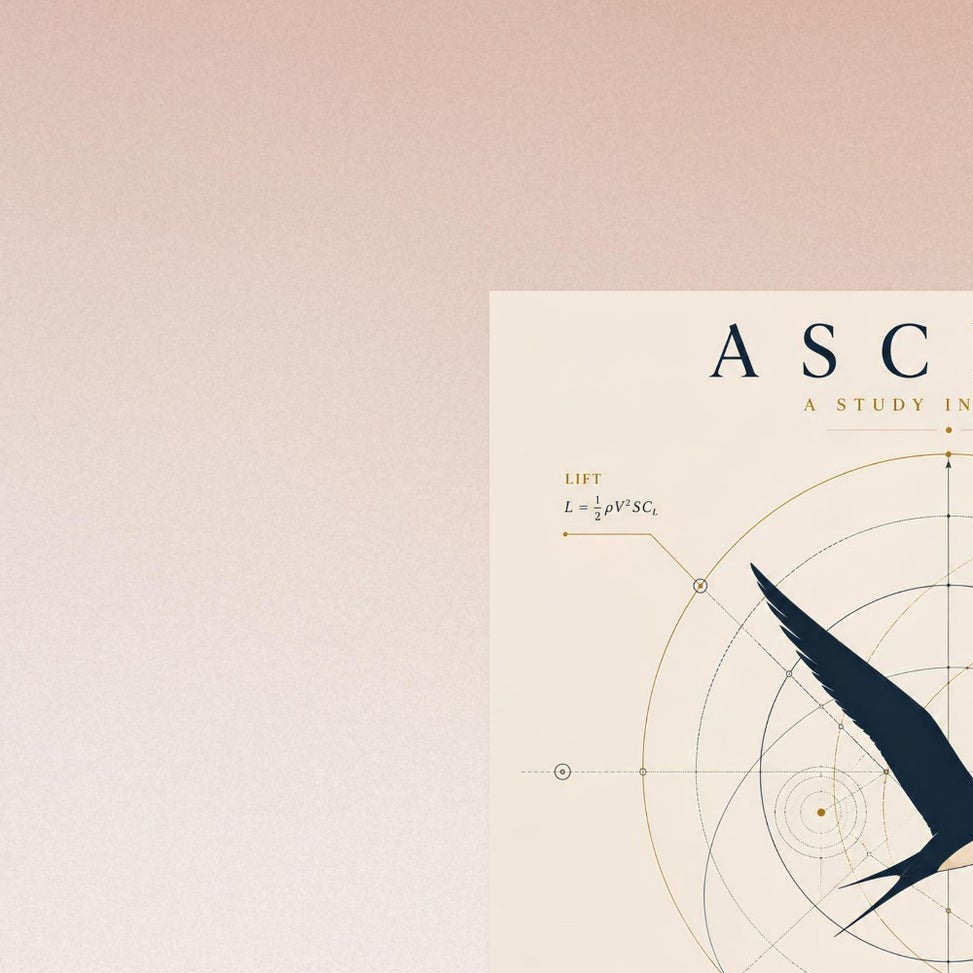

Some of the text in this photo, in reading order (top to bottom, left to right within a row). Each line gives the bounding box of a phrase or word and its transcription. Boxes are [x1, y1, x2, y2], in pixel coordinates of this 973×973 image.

[803, 397, 816, 412] A
[836, 397, 924, 412] STUDY
[945, 397, 970, 412] IN
[565, 472, 602, 485] LIFT
